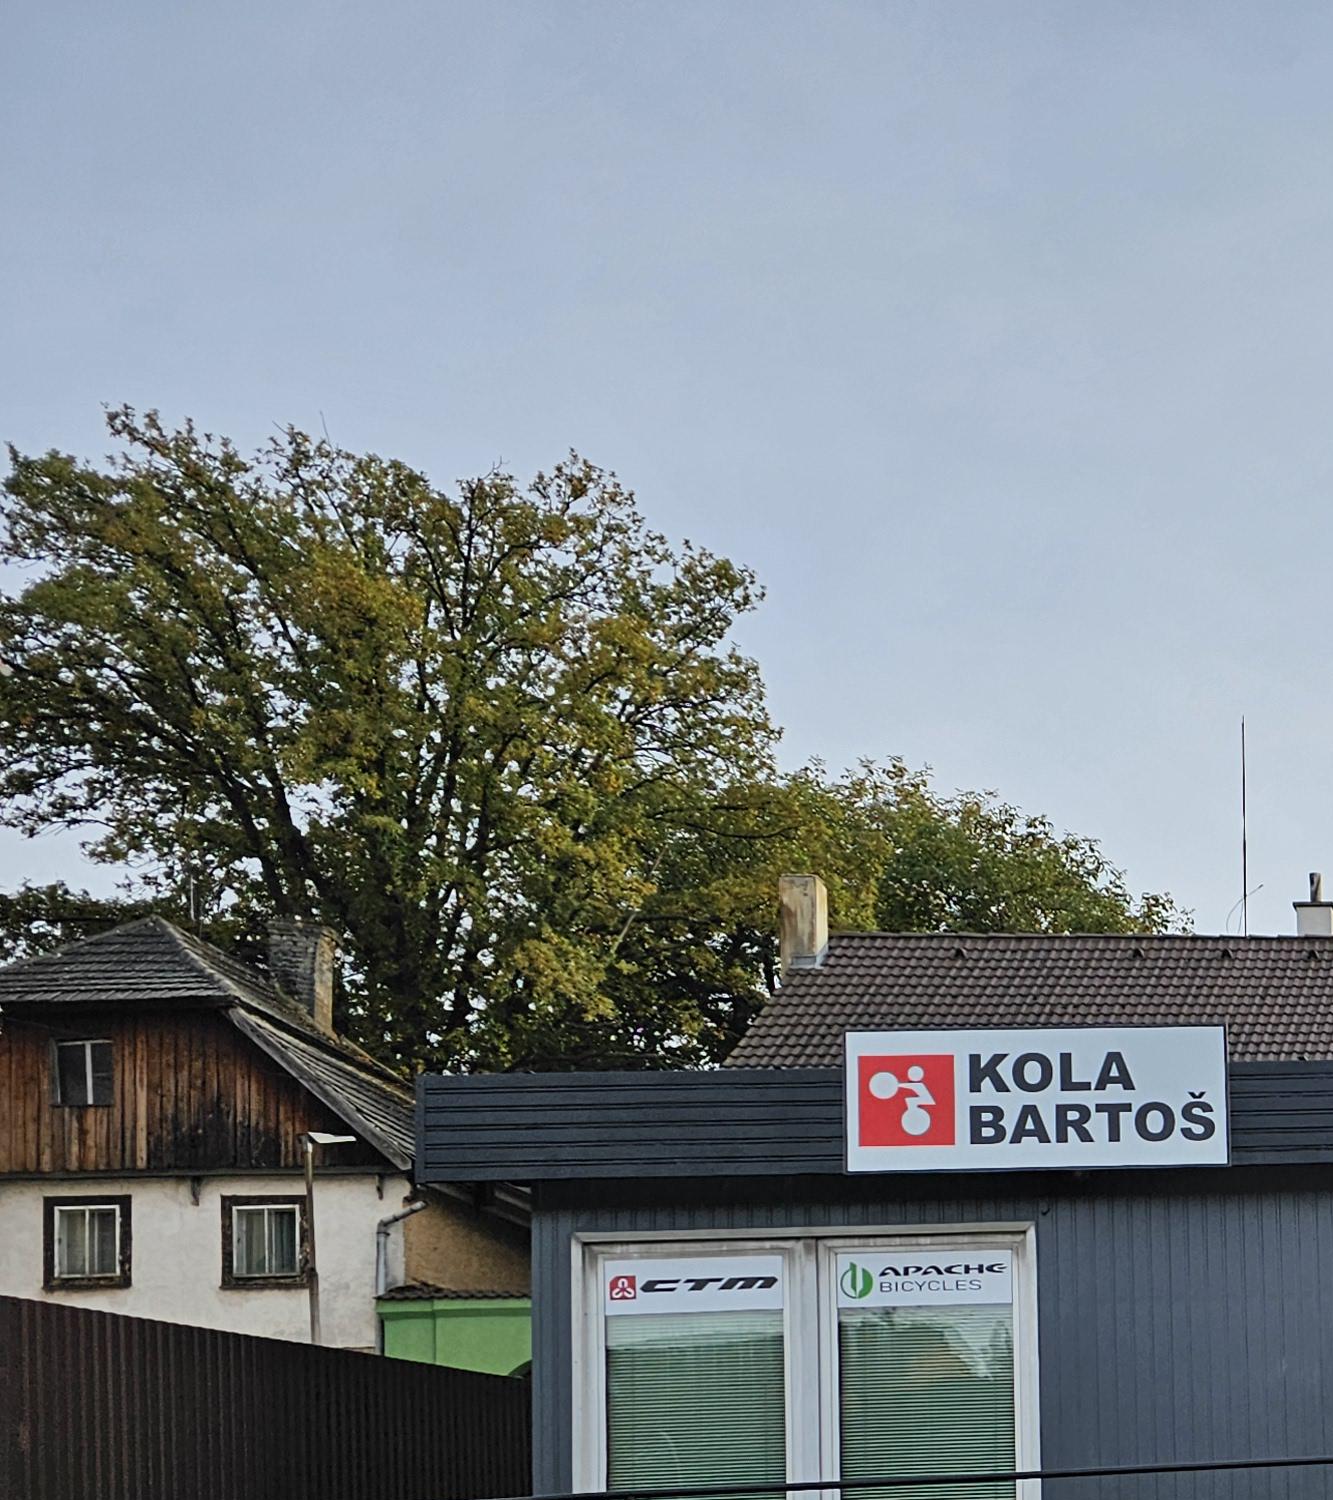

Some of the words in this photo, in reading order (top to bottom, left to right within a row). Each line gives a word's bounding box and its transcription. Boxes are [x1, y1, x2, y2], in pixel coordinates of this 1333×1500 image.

[968, 1051, 1136, 1093] KOLA
[969, 1091, 1216, 1145] BARTOŠ
[878, 1263, 1009, 1278] APACHE
[640, 1275, 779, 1294] CTM
[879, 1278, 982, 1293] BICYCLES
